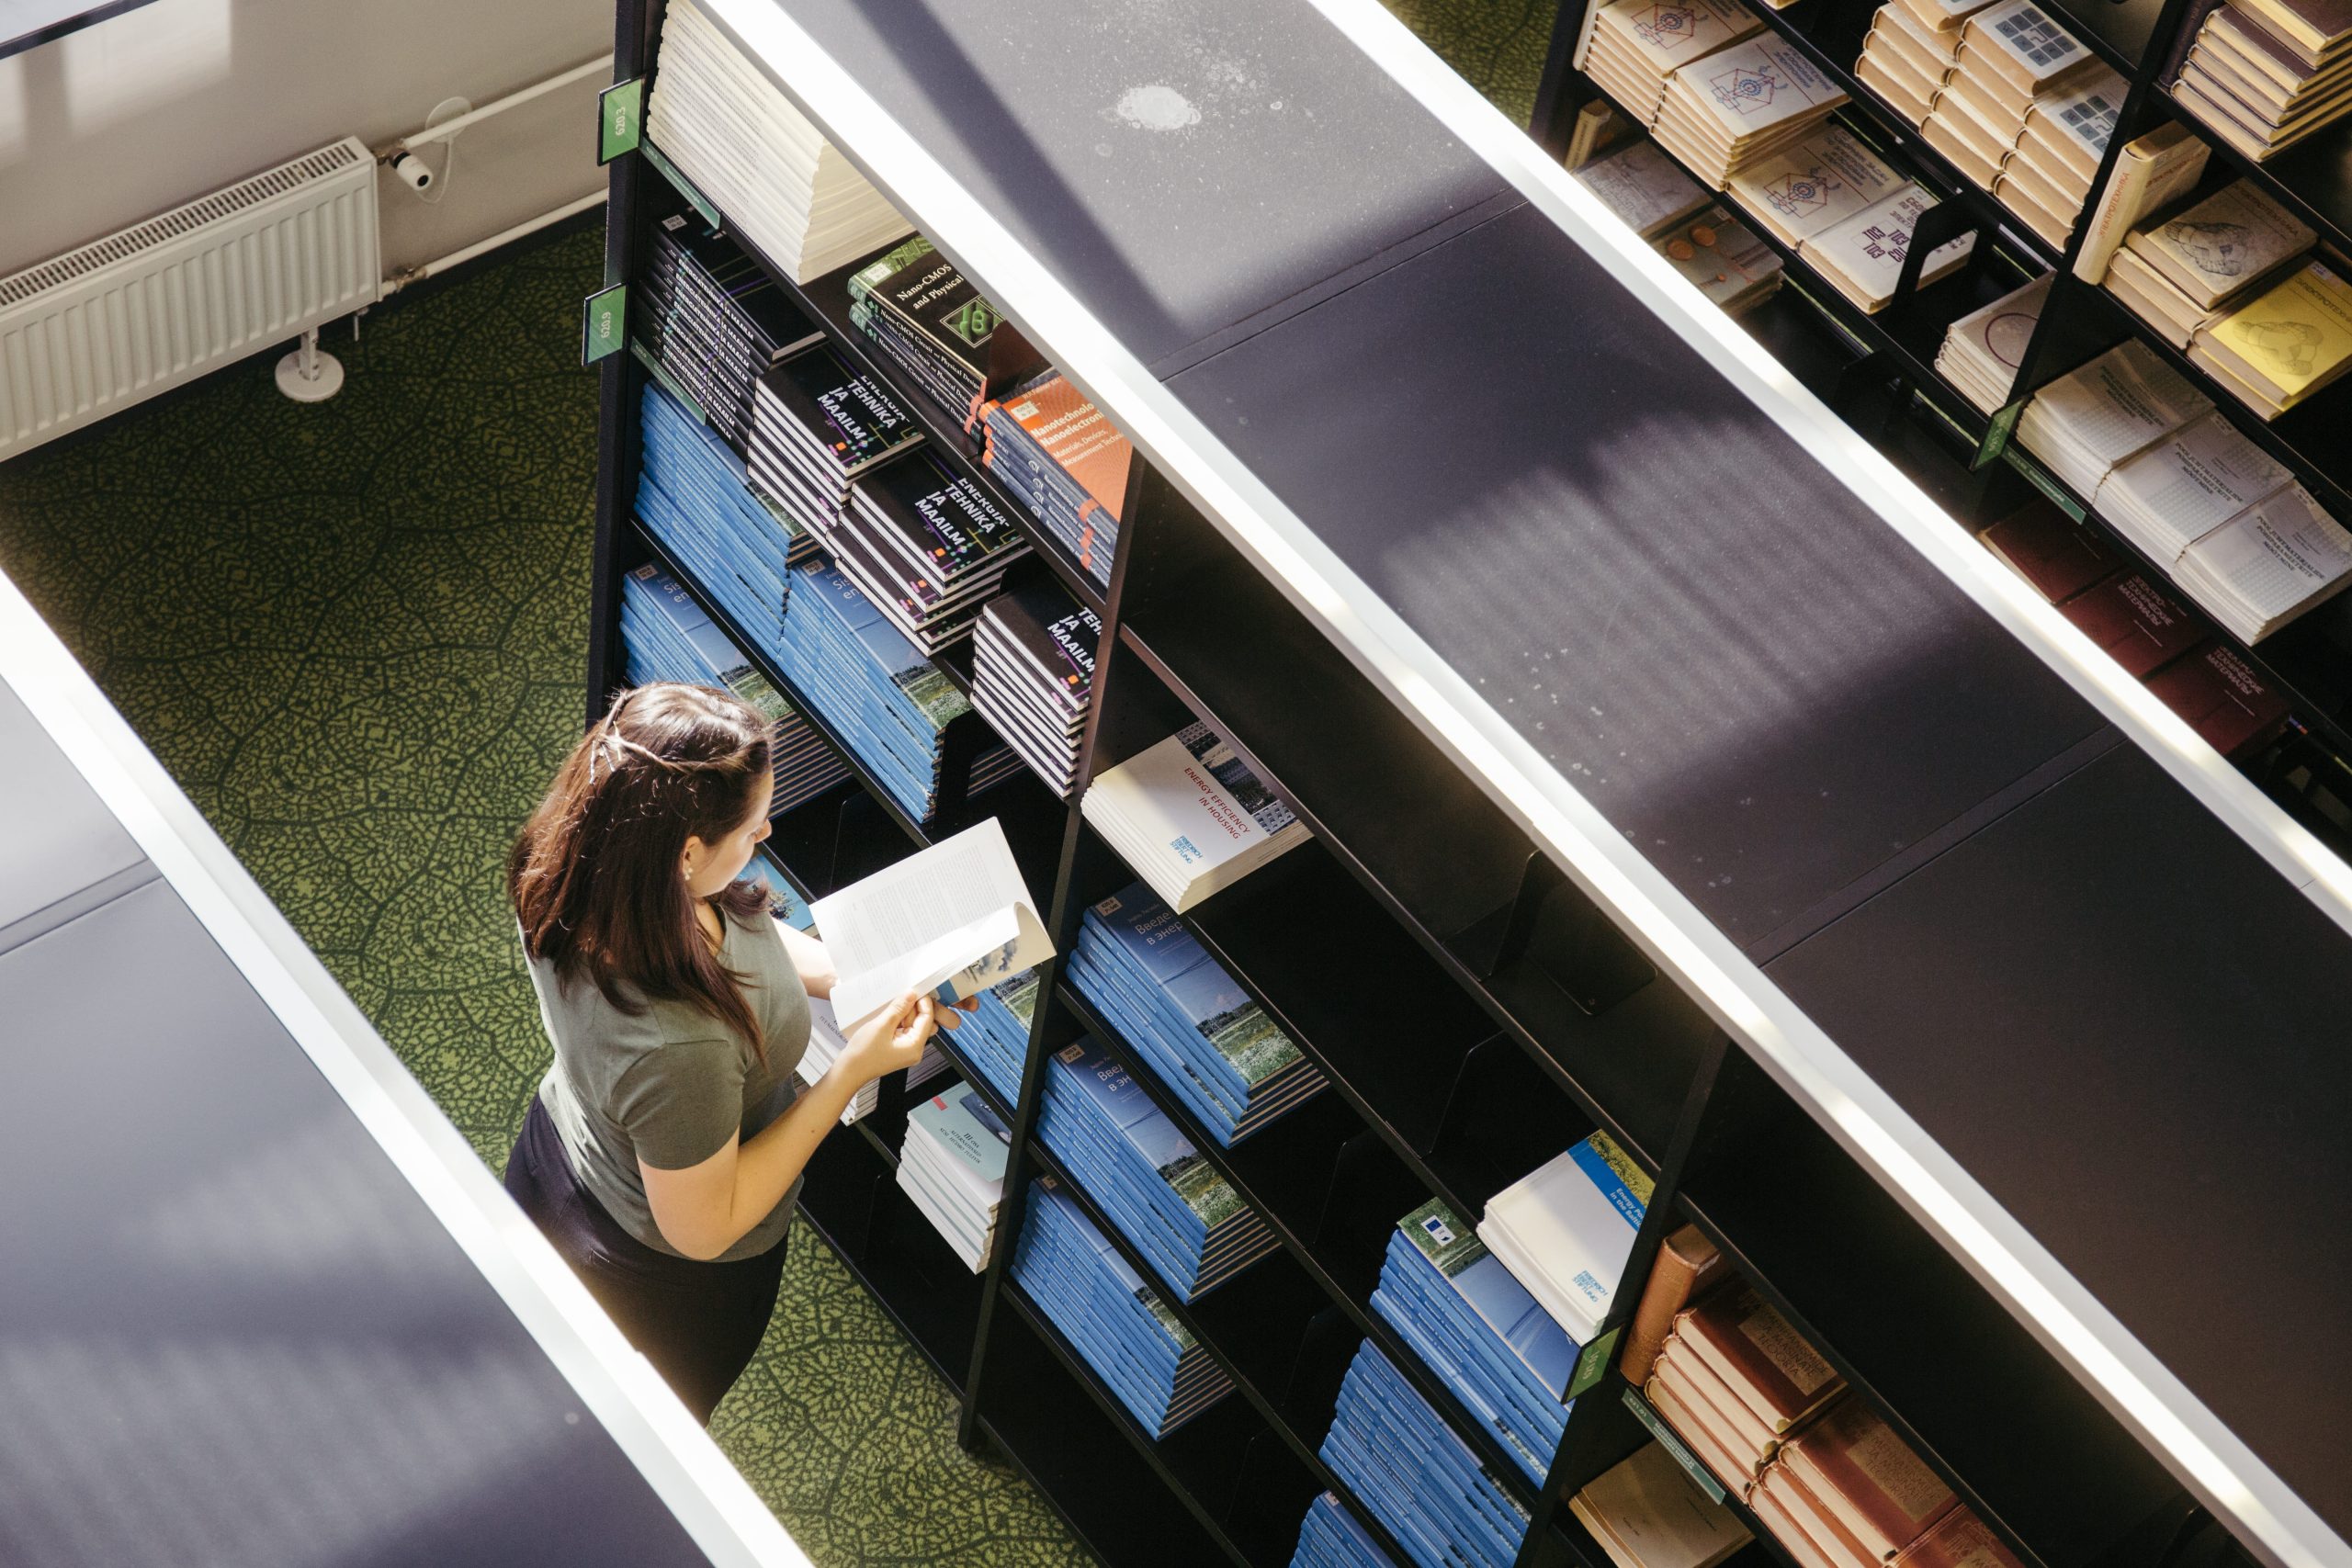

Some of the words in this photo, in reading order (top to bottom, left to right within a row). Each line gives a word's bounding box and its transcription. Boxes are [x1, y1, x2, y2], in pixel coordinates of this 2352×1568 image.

[615, 107, 626, 136] 620.3
[897, 264, 952, 301] Nano-CMOS
[912, 295, 930, 310] and
[928, 274, 965, 300] Physical
[601, 311, 611, 339] 620.9
[828, 387, 849, 401] JA
[847, 379, 897, 429] TEHNIKA
[818, 393, 867, 440] MAAILM
[926, 491, 947, 505] JA
[944, 483, 997, 534] TEHNIKA
[914, 499, 966, 546] MAAILM
[1059, 615, 1080, 631] JA
[1047, 623, 1095, 672] MAAILM
[1184, 767, 1213, 795] ENERGY
[1211, 795, 1250, 833] EFFICIENCY
[1199, 796, 1209, 807] IN
[1207, 806, 1241, 840] HOUSING
[1135, 910, 1172, 935] Введе
[1610, 1191, 1617, 1200] in
[1616, 1199, 1626, 1211] the
[1616, 1188, 1635, 1210] Energy
